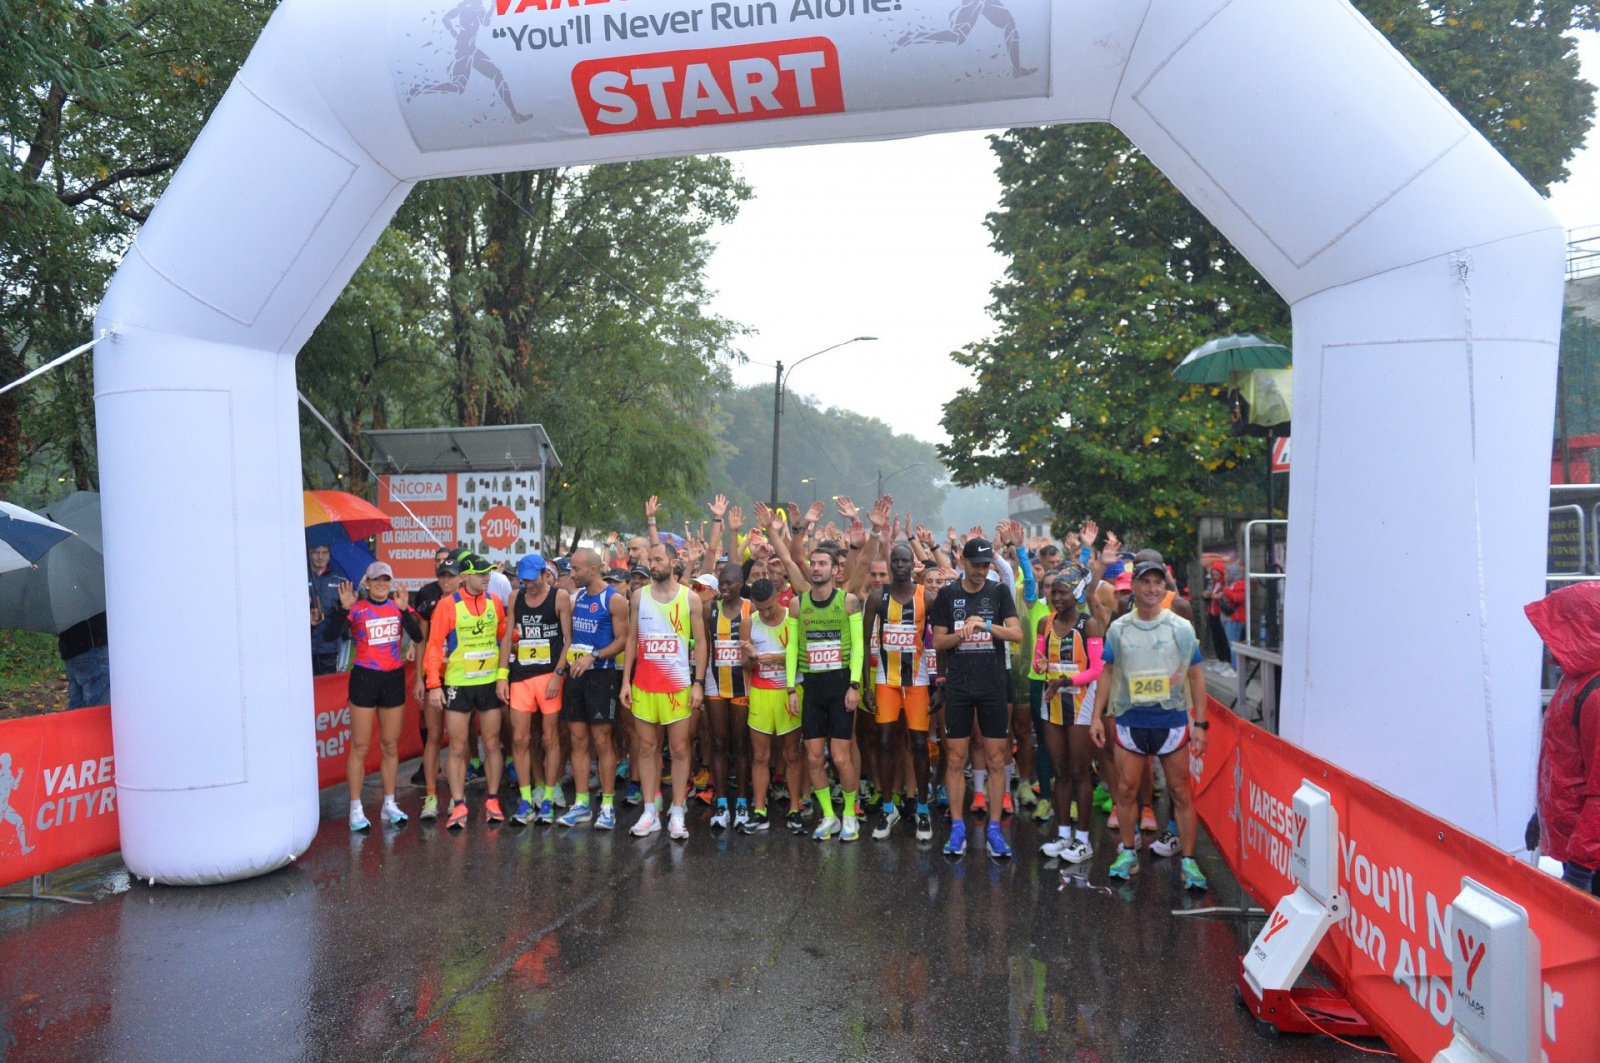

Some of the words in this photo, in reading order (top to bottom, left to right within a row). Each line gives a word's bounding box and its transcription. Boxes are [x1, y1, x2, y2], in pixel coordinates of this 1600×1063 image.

[604, 9, 703, 41] Never
[711, 2, 777, 30] Run
[589, 51, 825, 125] START
[390, 515, 453, 529] BIGLIAMENTO
[481, 519, 518, 538] -20%
[382, 531, 394, 543] DA
[388, 549, 437, 560] VERDEMA
[522, 615, 542, 624] EA7
[369, 624, 398, 638] 1046
[885, 633, 914, 645] 1003
[530, 648, 537, 659] 2
[645, 641, 675, 652] 1043
[810, 650, 839, 662] 1002
[478, 660, 486, 670] 7
[1134, 680, 1163, 694] 246
[43, 756, 116, 796] VARE
[36, 786, 117, 830] CITYR
[1250, 780, 1293, 841] VARESE
[1458, 989, 1485, 1015] MYLAPS
